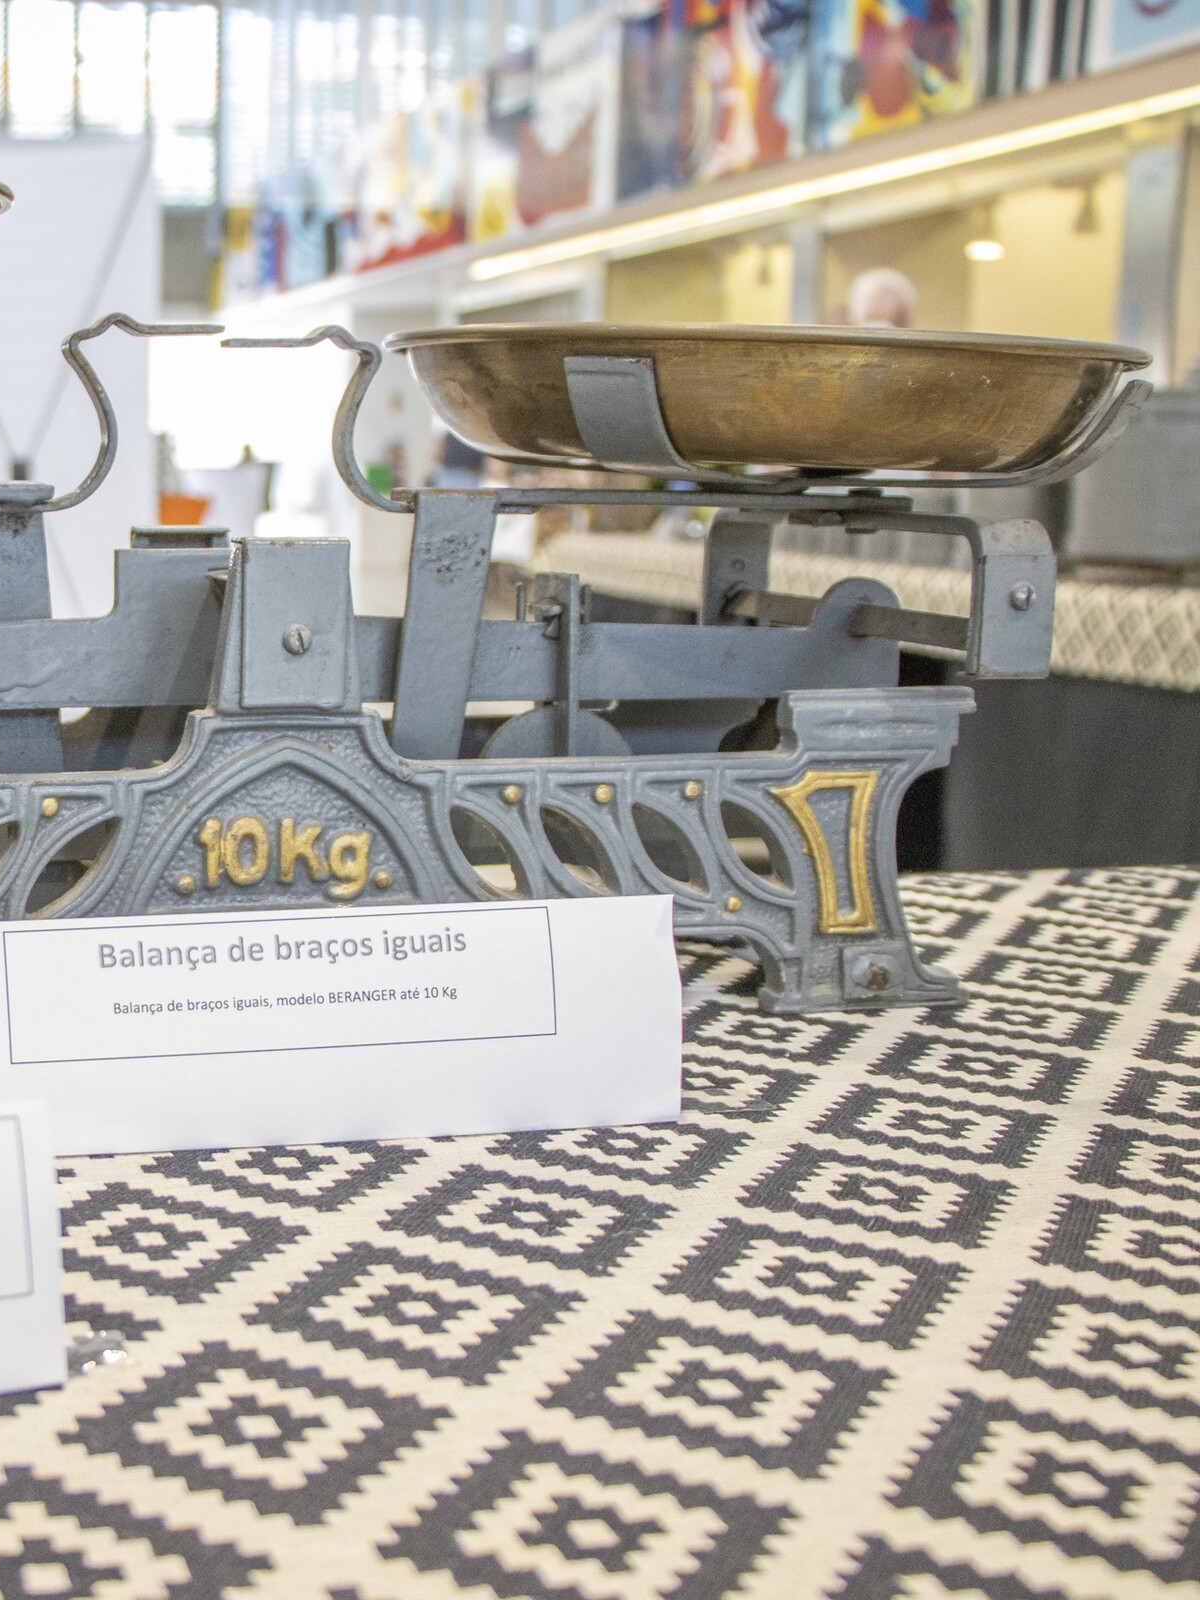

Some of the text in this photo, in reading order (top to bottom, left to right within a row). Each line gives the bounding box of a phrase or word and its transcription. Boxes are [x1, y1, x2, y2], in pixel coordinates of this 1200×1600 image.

[98, 926, 467, 972] Balança de braços iguais
[113, 986, 458, 1016] Balança de braços iguais, modelo BERANGER até 10 Kg
